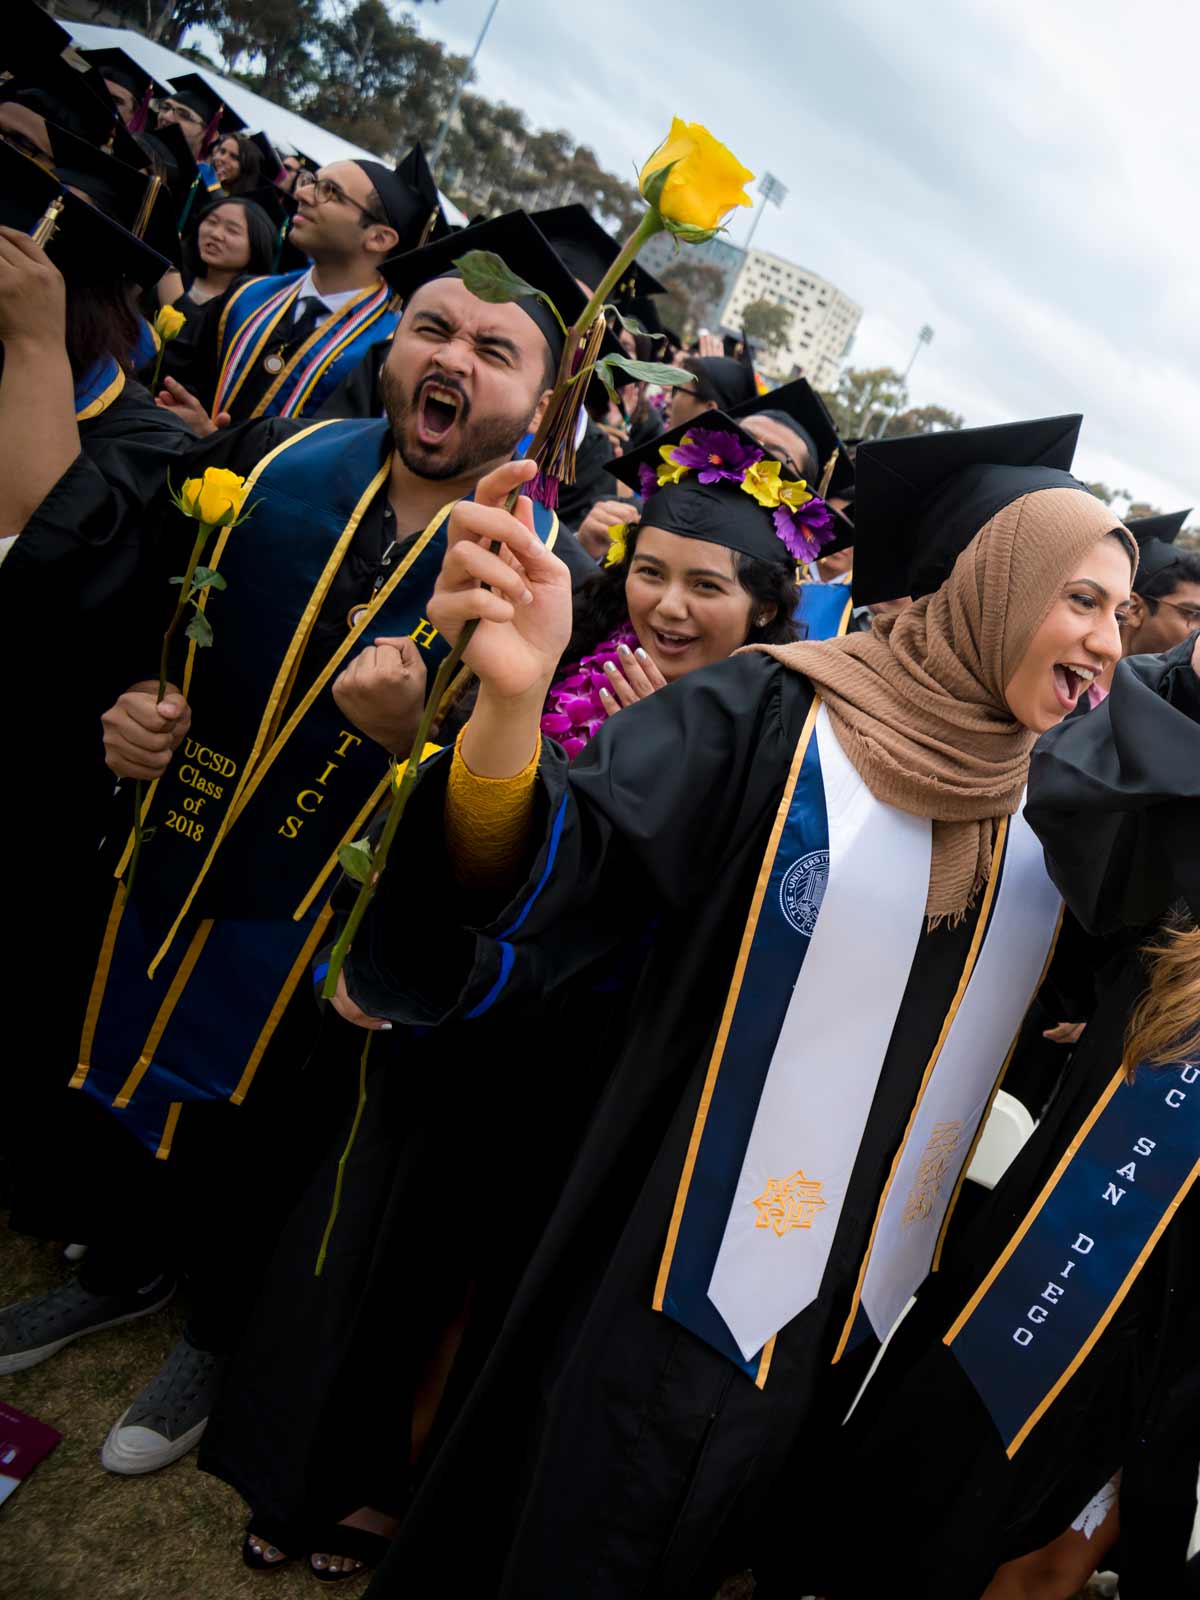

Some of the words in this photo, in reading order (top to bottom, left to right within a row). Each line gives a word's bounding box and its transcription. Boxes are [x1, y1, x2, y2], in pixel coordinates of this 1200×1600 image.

[184, 737, 237, 778] UCSD
[178, 764, 224, 800] Class
[183, 797, 206, 815] of
[165, 810, 205, 842] 2018
[787, 855, 830, 890] UNIVERSIT
[787, 896, 799, 918] THE
[1101, 1136, 1157, 1207] SAN
[1012, 1232, 1095, 1347] DIEGO
